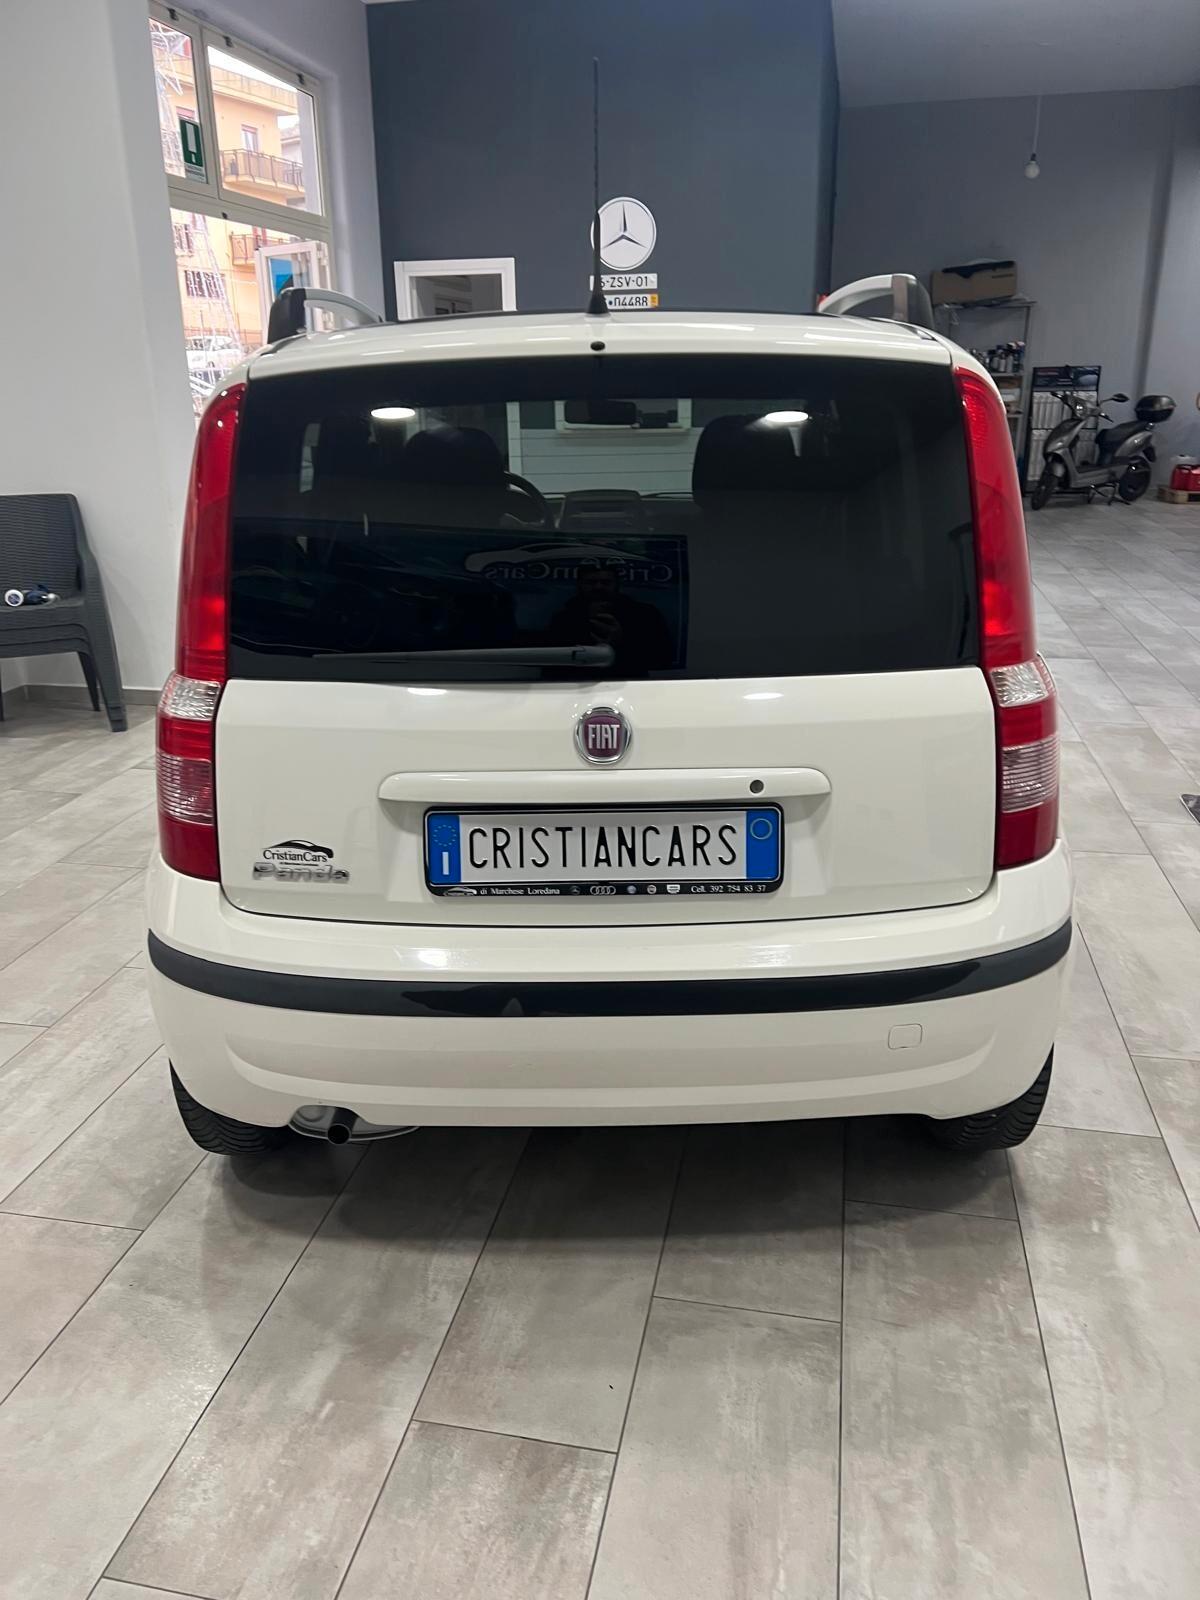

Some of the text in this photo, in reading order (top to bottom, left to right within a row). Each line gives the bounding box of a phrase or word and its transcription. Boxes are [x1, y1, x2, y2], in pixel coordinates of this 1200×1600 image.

[588, 724, 620, 749] FIAT
[468, 824, 738, 868] CRISTIANCARS
[263, 849, 328, 863] CristianCars
[480, 887, 488, 895] di
[490, 887, 524, 895] Marchese
[527, 887, 560, 895] Loredana
[710, 885, 724, 893] 392
[757, 884, 766, 892] 37
